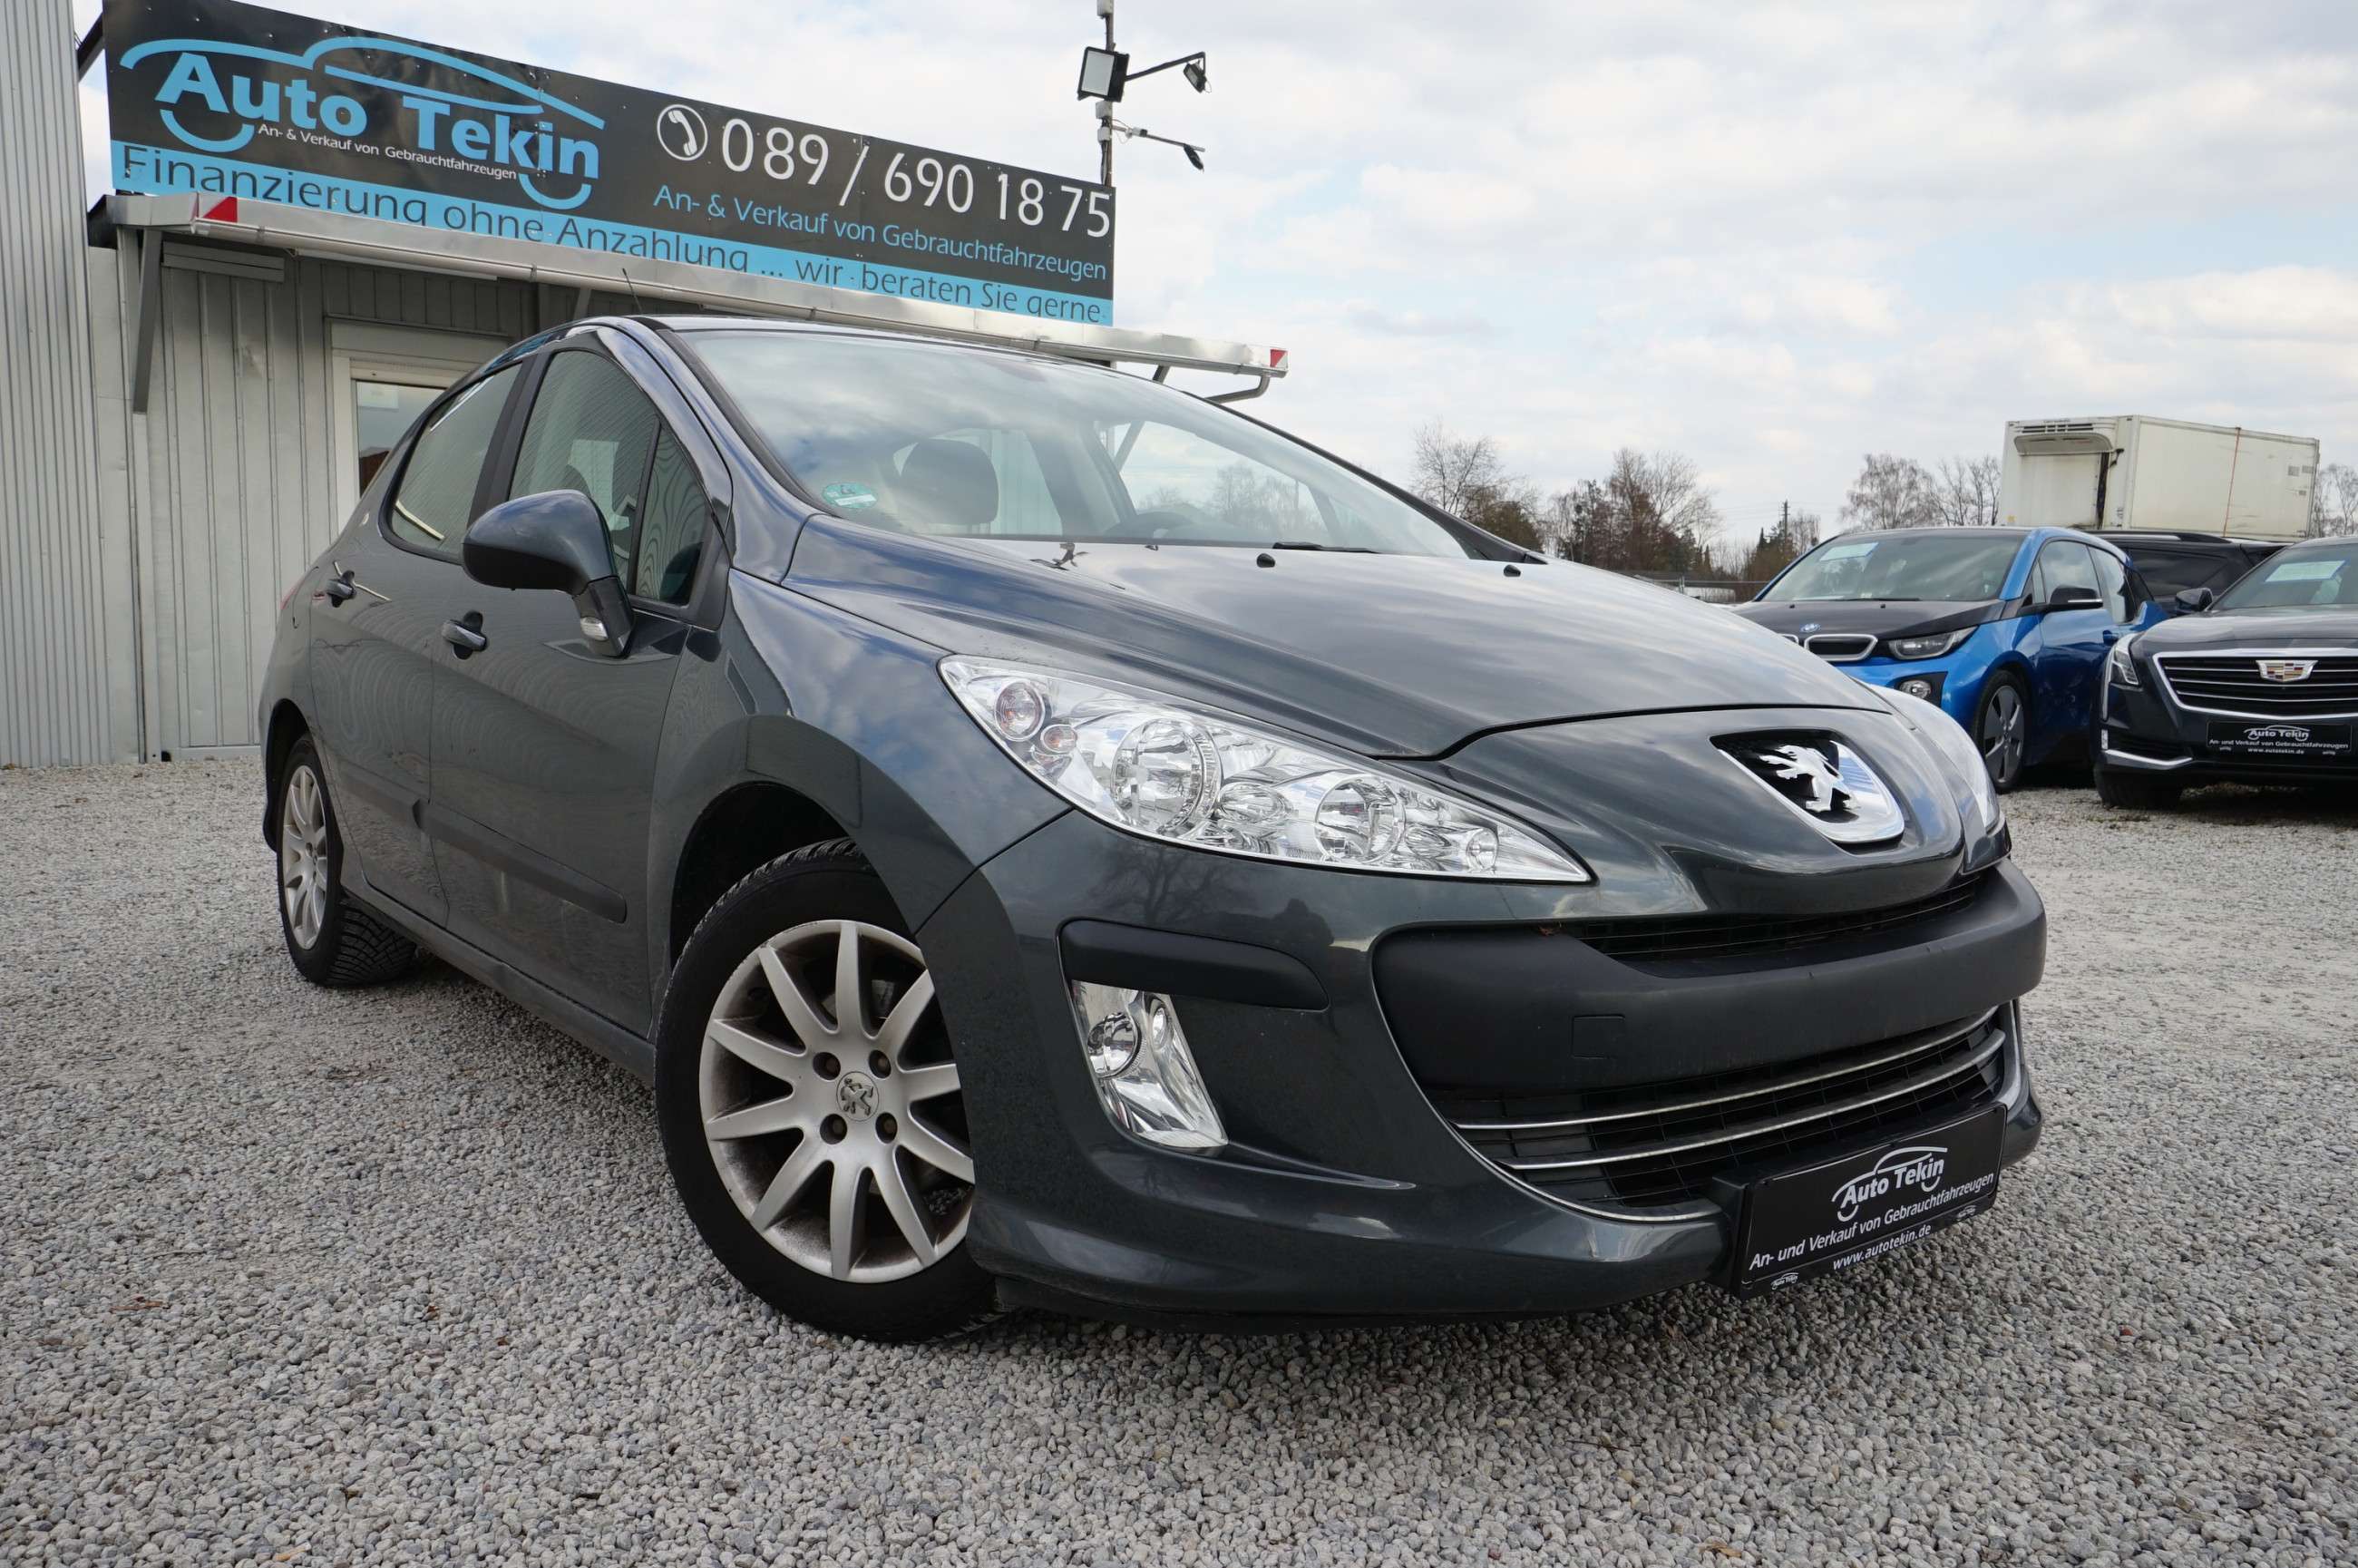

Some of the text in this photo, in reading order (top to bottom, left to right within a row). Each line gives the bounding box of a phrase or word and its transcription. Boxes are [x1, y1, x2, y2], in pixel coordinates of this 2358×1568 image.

[154, 53, 599, 180] Auto Tekin
[258, 123, 517, 181] An- & Verkauf von Gebrauchtfahrzeugen
[721, 118, 829, 186] 089
[884, 152, 974, 214] 690
[998, 173, 1045, 226] 18
[1060, 185, 1111, 239] 75
[123, 145, 426, 228] Finanzierung
[443, 201, 543, 242] ohne
[556, 217, 748, 274] Anzahlung
[794, 257, 844, 286] wir
[862, 268, 970, 306] beraten
[981, 282, 1018, 310] Sie
[1027, 295, 1100, 324] gerne
[653, 184, 1106, 283] An- & Verkauf von Gebrauchtfahrzeugen
[2249, 729, 2309, 738] Auto Tekin
[2275, 741, 2349, 750] Gebrauchtfahrzeugen
[1749, 1252, 1775, 1270] An-
[1778, 1239, 1806, 1261] und
[1809, 1223, 1857, 1251] Verkauf
[1859, 1215, 1881, 1233] von
[1884, 1172, 1994, 1225] Gebrauchtfahrzeugen
[1840, 1157, 1944, 1209] Auto Tekin
[1833, 1223, 1932, 1271] www.autotekin.de
